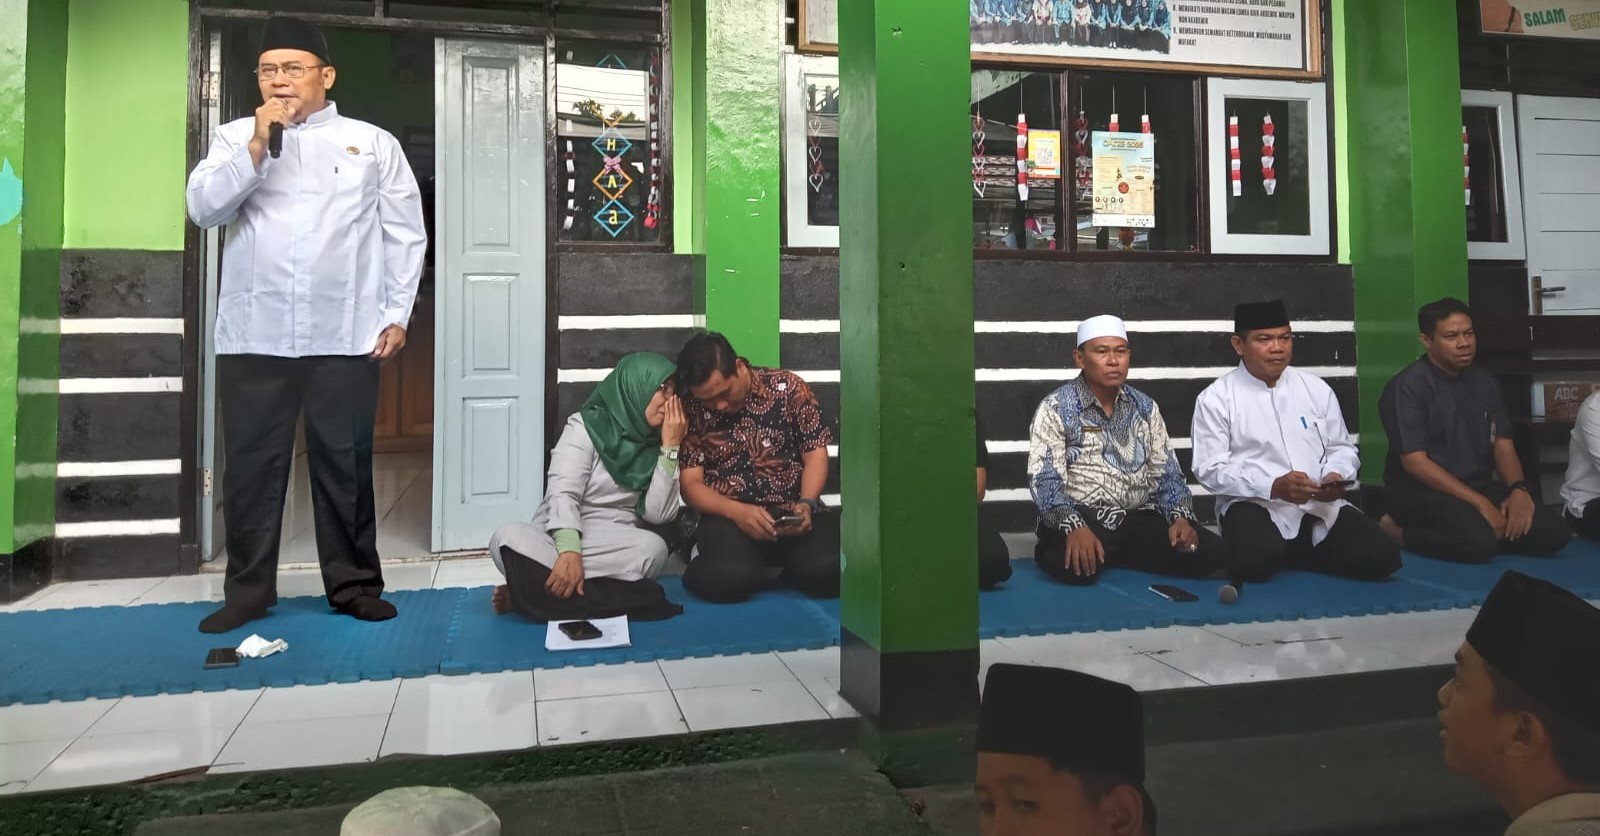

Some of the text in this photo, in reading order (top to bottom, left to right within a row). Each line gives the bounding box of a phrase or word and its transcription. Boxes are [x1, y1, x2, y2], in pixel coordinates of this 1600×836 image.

[1524, 8, 1566, 27] SALAM
[608, 210, 618, 224] a
[1554, 387, 1579, 400] ABC
